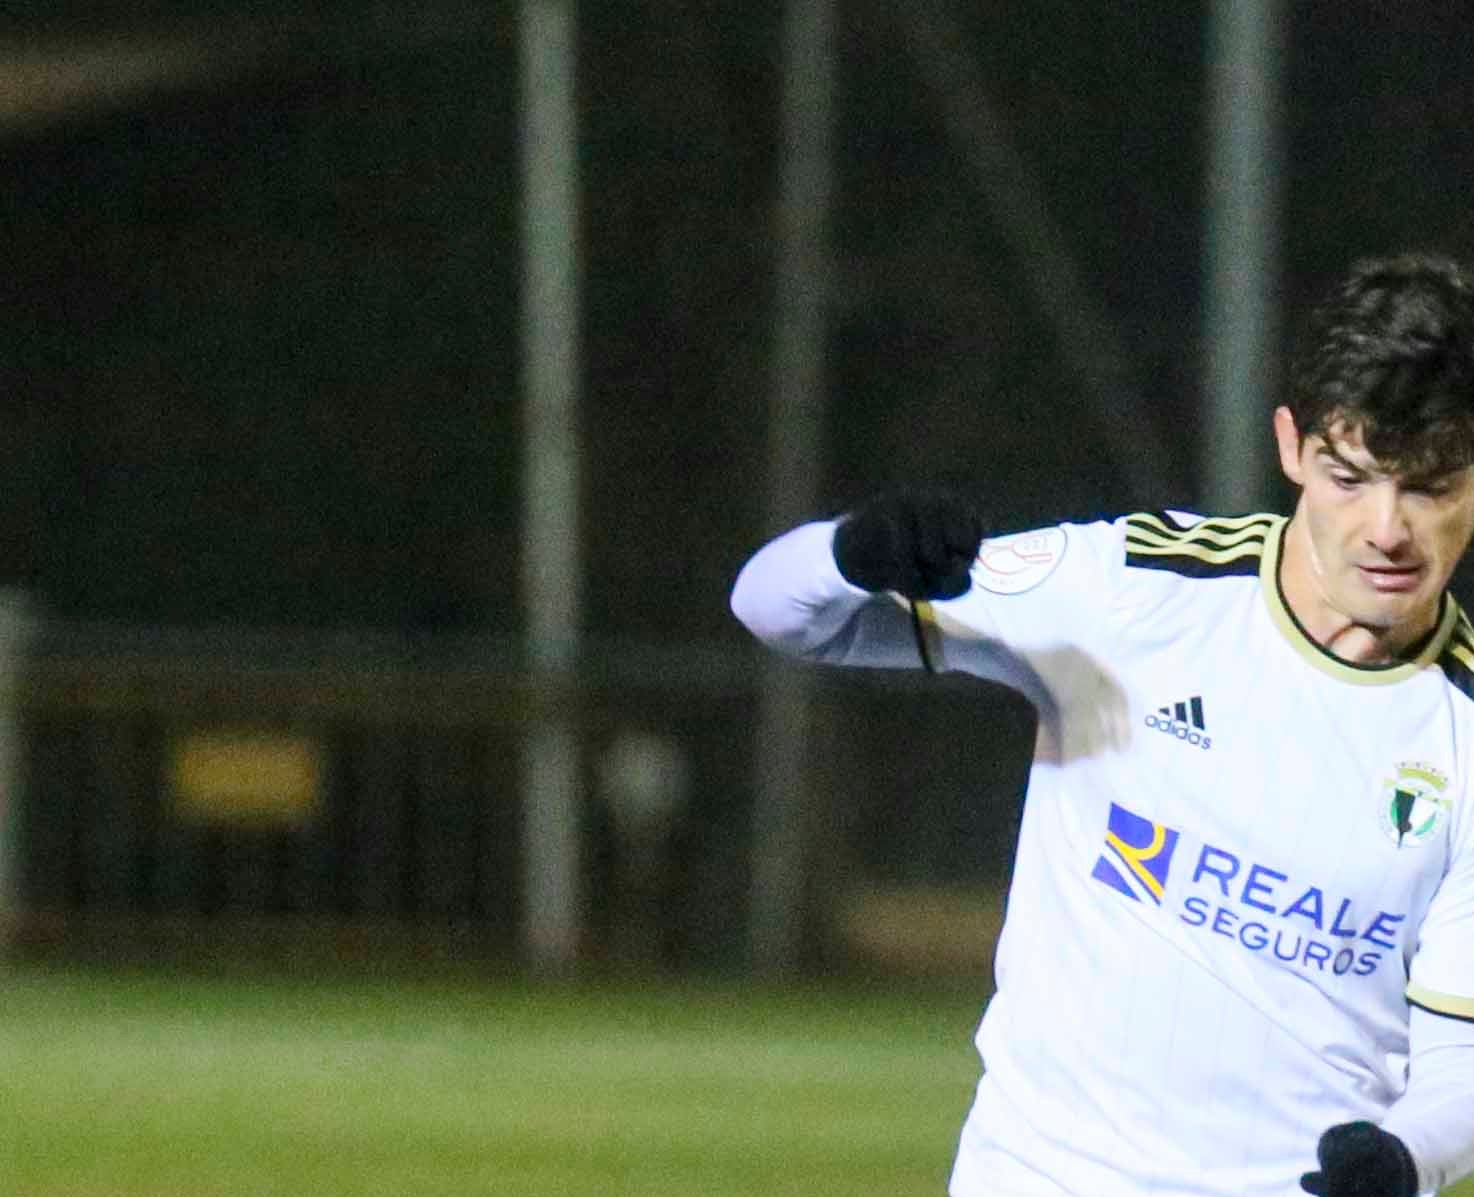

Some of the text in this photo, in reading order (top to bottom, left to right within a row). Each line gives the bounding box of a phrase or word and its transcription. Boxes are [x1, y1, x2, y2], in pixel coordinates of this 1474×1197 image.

[1144, 715, 1211, 750] adidas
[1179, 896, 1382, 976] SEGUROS
[1192, 843, 1407, 950] REALE
